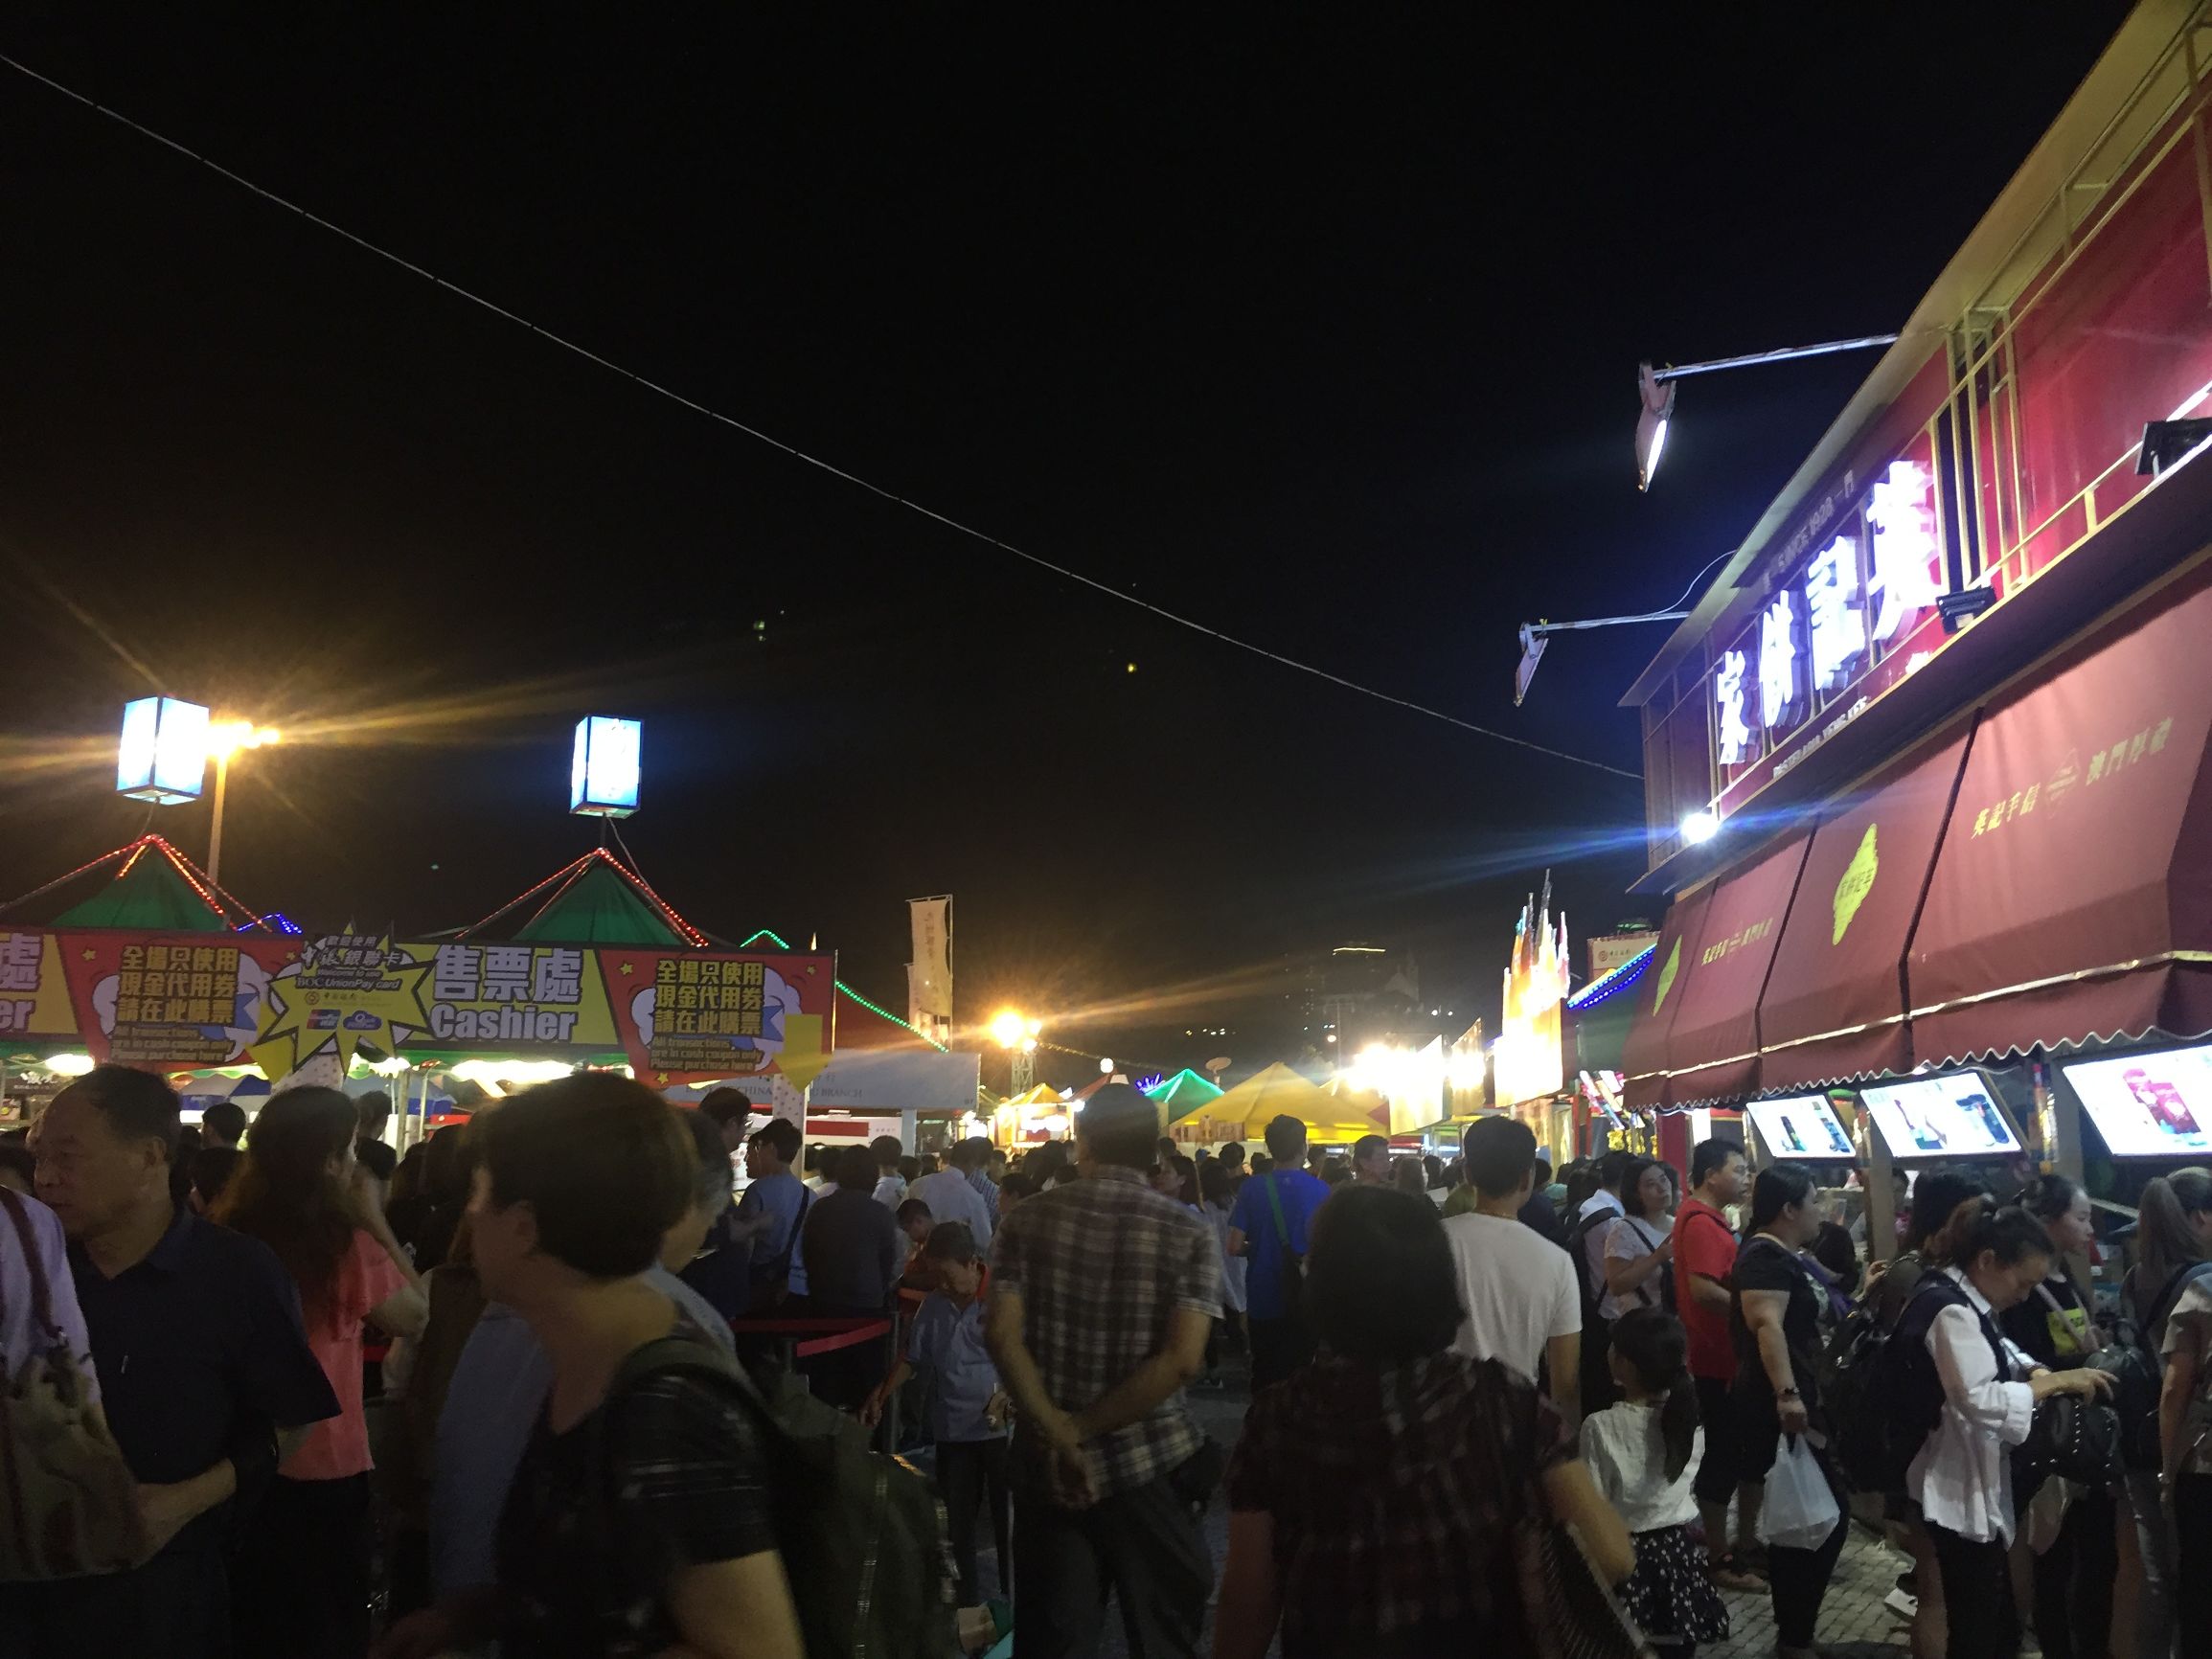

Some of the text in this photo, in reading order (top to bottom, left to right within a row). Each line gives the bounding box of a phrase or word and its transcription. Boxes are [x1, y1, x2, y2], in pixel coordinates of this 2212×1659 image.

[122, 945, 239, 971] 全場只使用
[120, 971, 236, 997] 現金代用券
[297, 978, 400, 990] BOC UnionPay card
[431, 944, 582, 1003] 售票處
[656, 960, 764, 985] 全場只使用
[116, 997, 234, 1023] 請在此購票
[655, 985, 763, 1011] 現金代用券
[431, 1003, 579, 1042] Cashier
[653, 1010, 762, 1034] 請在此購票
[144, 1039, 171, 1050] cash
[651, 1037, 731, 1049] All transactions
[650, 1050, 671, 1058] are
[680, 1050, 704, 1059] cash
[705, 1051, 741, 1062] coupon
[742, 1051, 764, 1062] only
[650, 1058, 754, 1072] Please purchase here
[821, 1087, 863, 1098] BRANCH
